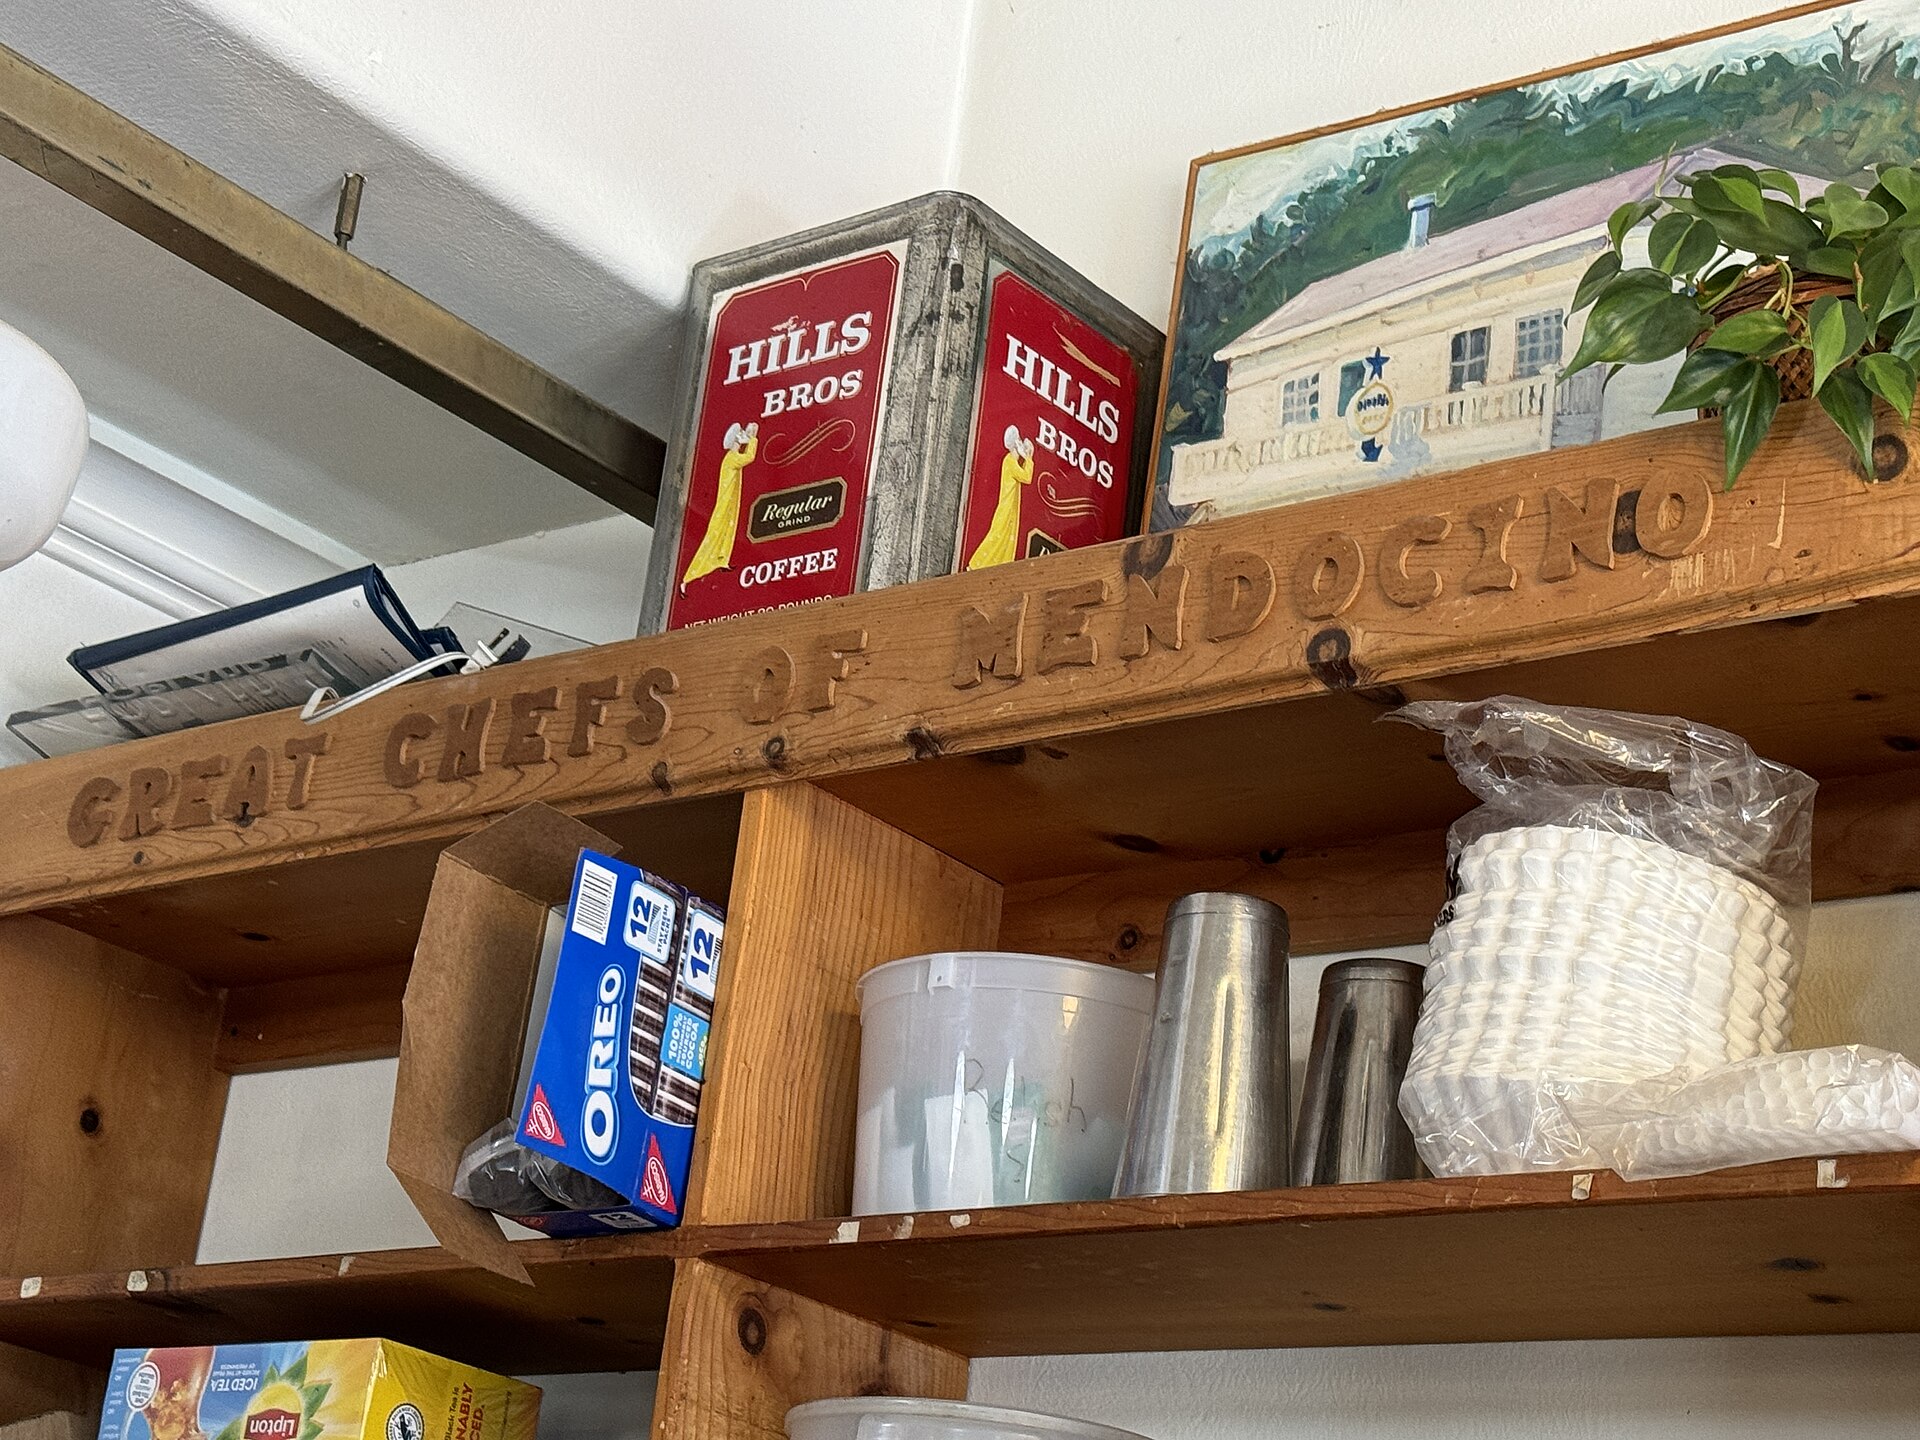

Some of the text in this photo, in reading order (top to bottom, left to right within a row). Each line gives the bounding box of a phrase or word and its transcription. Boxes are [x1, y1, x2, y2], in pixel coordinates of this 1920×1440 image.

[723, 311, 872, 386] HILLS
[760, 369, 864, 418] BROS
[1002, 333, 1120, 445] HILLS
[1035, 416, 1114, 489] BROS
[761, 495, 833, 522] Regular
[777, 515, 811, 529] GRIND
[739, 548, 839, 589] COFFEE
[66, 467, 1714, 848] GREAT CHEFS OF MENDOCINO
[630, 895, 652, 938] 12
[691, 927, 714, 980] 12
[668, 1012, 683, 1060] 100%
[680, 1017, 693, 1067] SOURCED
[685, 1022, 700, 1070] COCOA
[584, 966, 624, 1158] OREO
[535, 1104, 551, 1137] NABISCO
[650, 1161, 666, 1202] NABISCO
[210, 1377, 259, 1392] ICED TEA
[250, 1415, 295, 1437] Lipton
